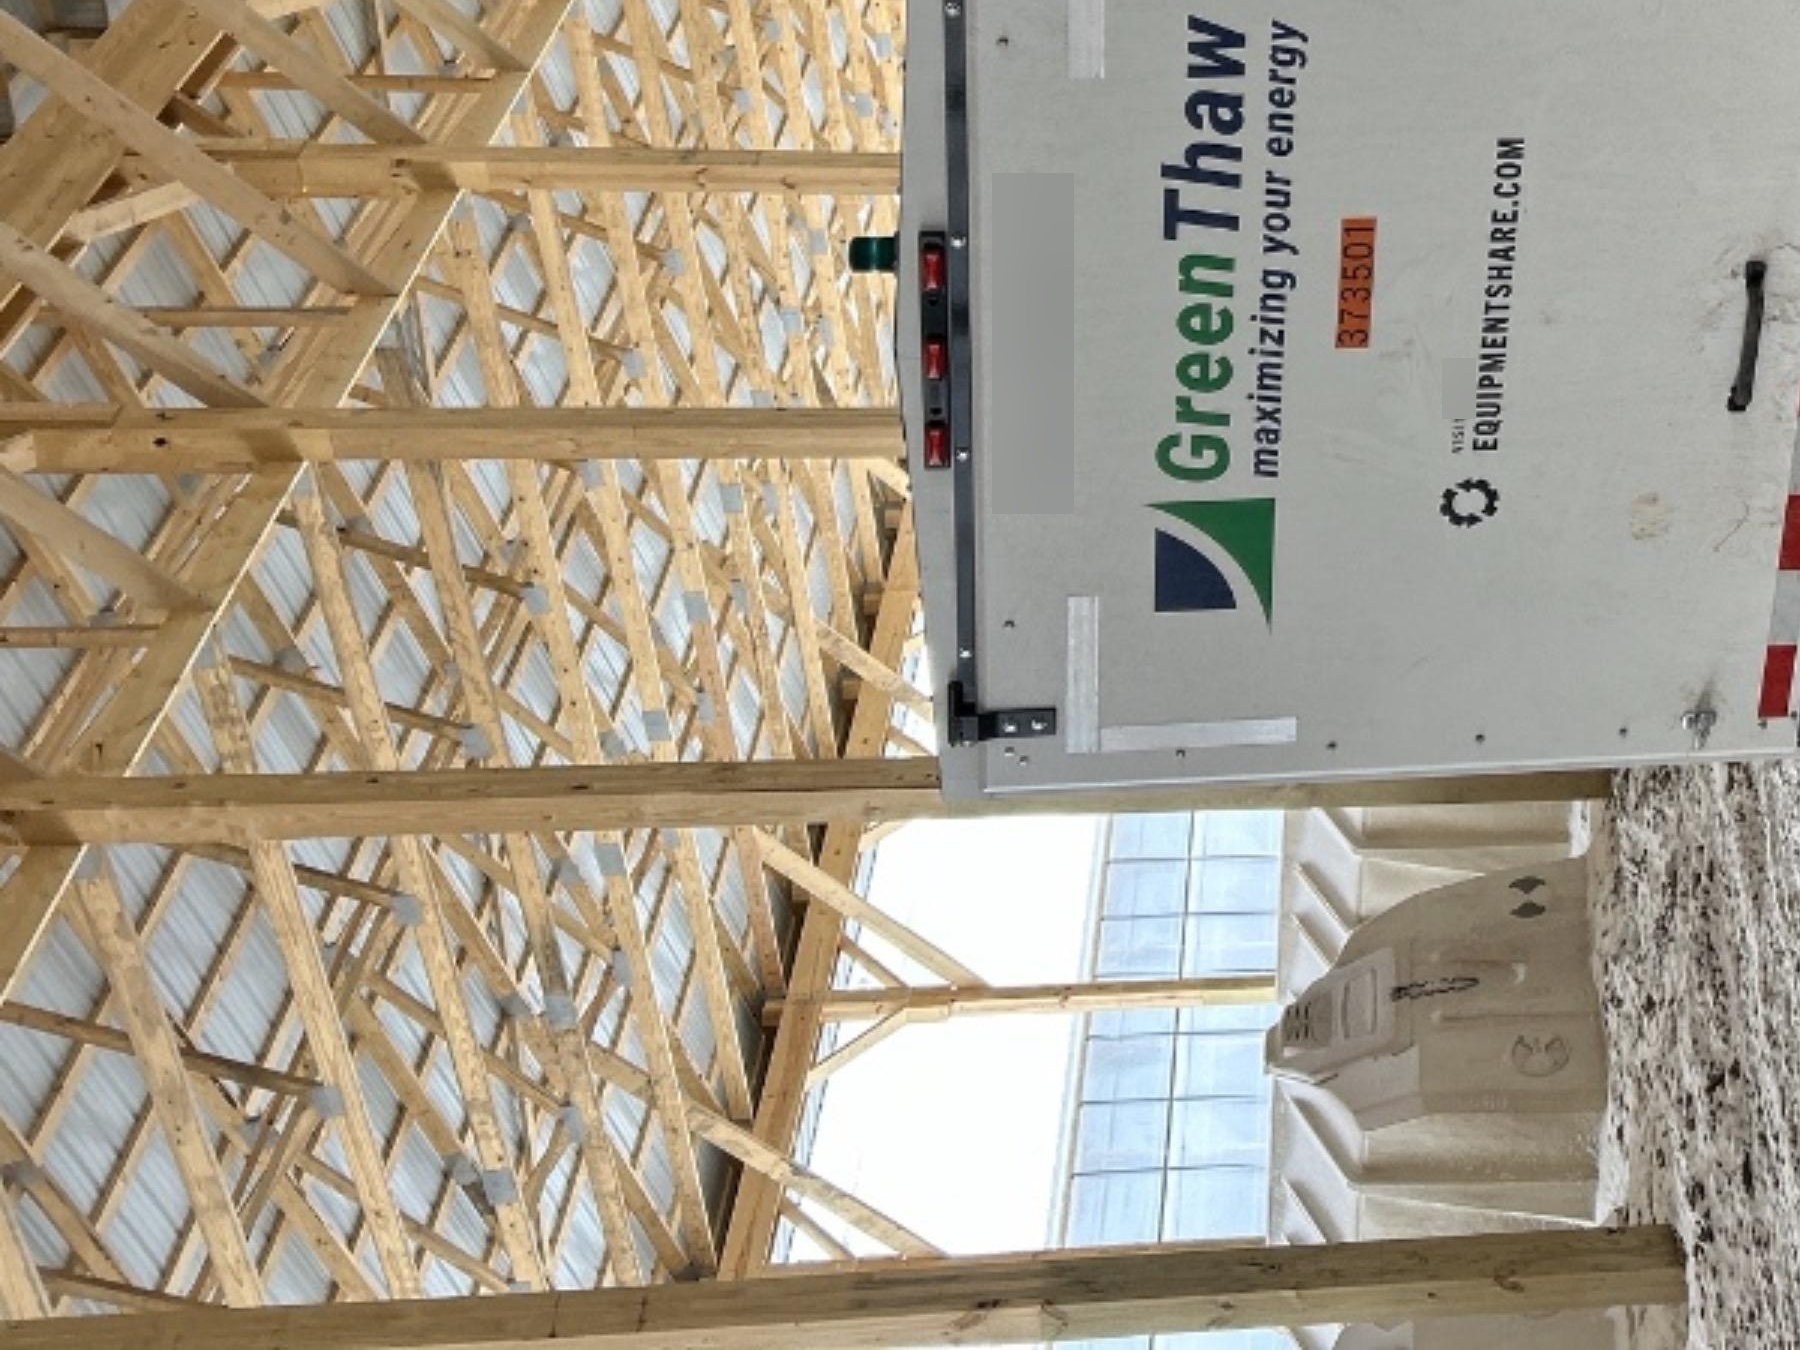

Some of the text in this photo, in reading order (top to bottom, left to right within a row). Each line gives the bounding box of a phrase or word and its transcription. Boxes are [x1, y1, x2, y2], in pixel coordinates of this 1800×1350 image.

[1246, 19, 1309, 479] maximizing your energy
[1336, 226, 1375, 347] 373501
[1471, 136, 1526, 452] EQUIPMENTSHARE.COM
